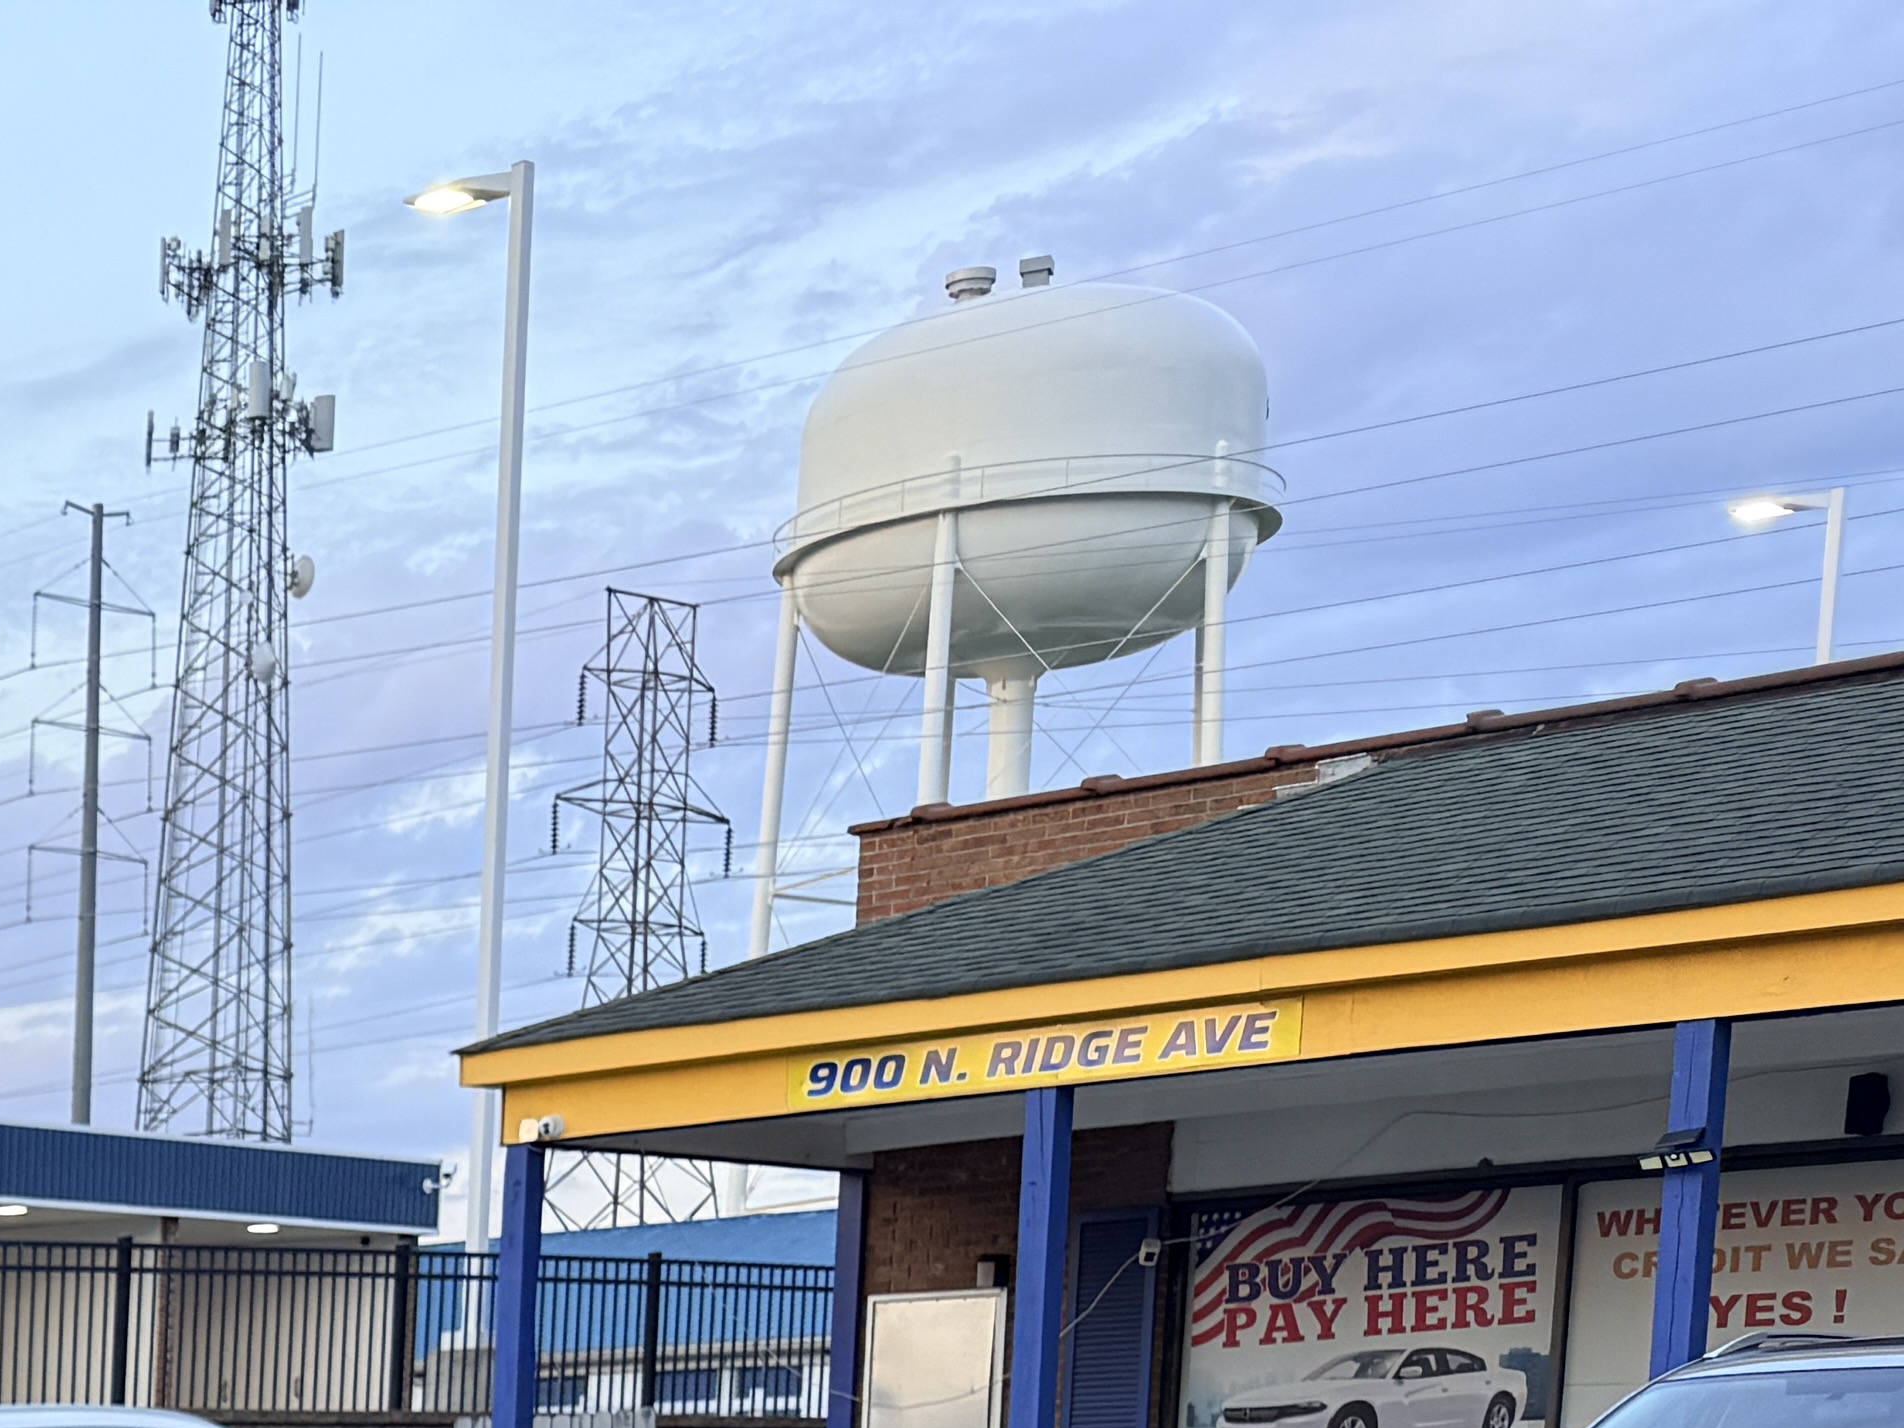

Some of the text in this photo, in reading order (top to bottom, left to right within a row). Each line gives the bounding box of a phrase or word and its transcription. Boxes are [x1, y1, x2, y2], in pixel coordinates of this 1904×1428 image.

[807, 1010, 1278, 1097] 900 N. RIDGE AVE
[1225, 1233, 1538, 1304] BUY HERE
[1785, 1239, 1854, 1270] WE
[1222, 1280, 1537, 1348] PAY HERE
[1709, 1290, 1814, 1329] YES
